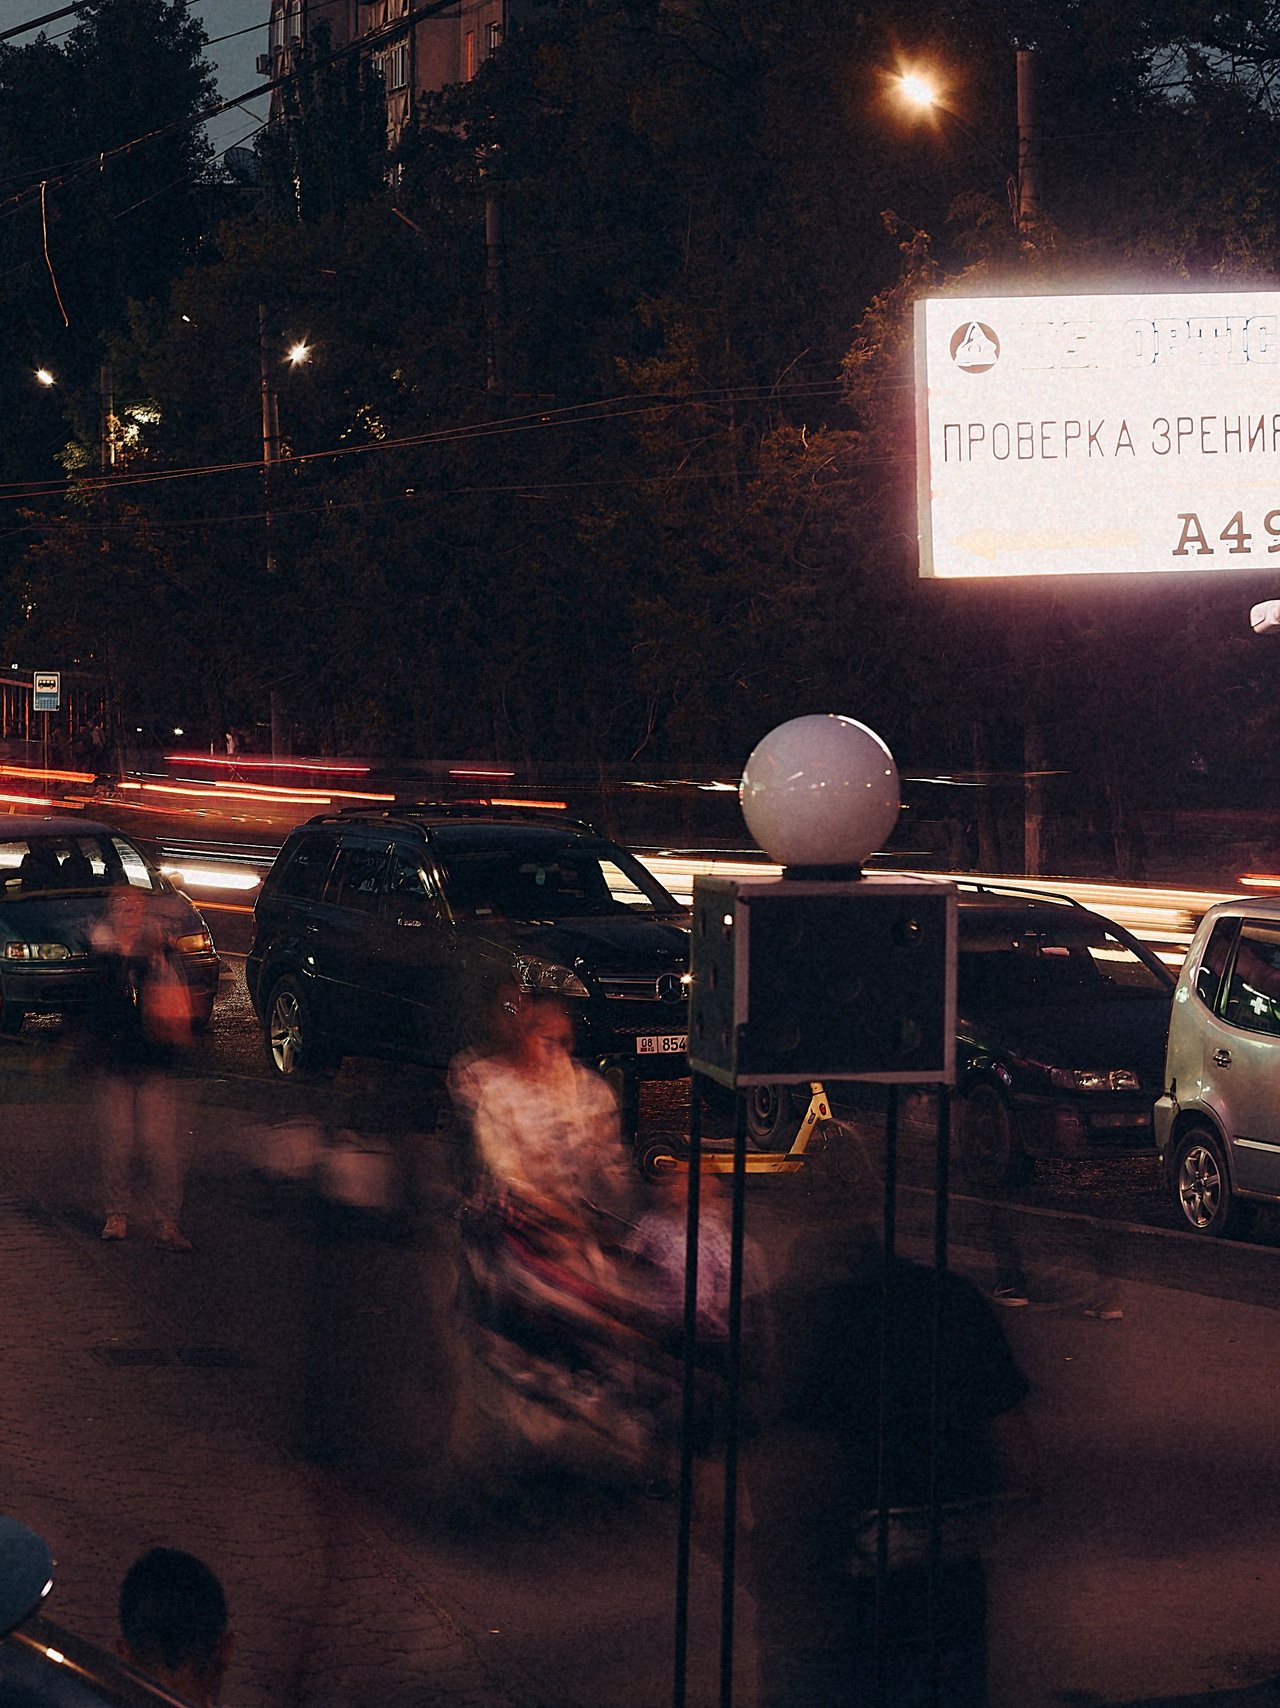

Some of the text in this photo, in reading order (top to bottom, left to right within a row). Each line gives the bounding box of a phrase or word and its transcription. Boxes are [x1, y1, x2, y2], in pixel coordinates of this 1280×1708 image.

[943, 418, 1137, 462] ПРОВЕРКА
[641, 1037, 687, 1051] 08 854
